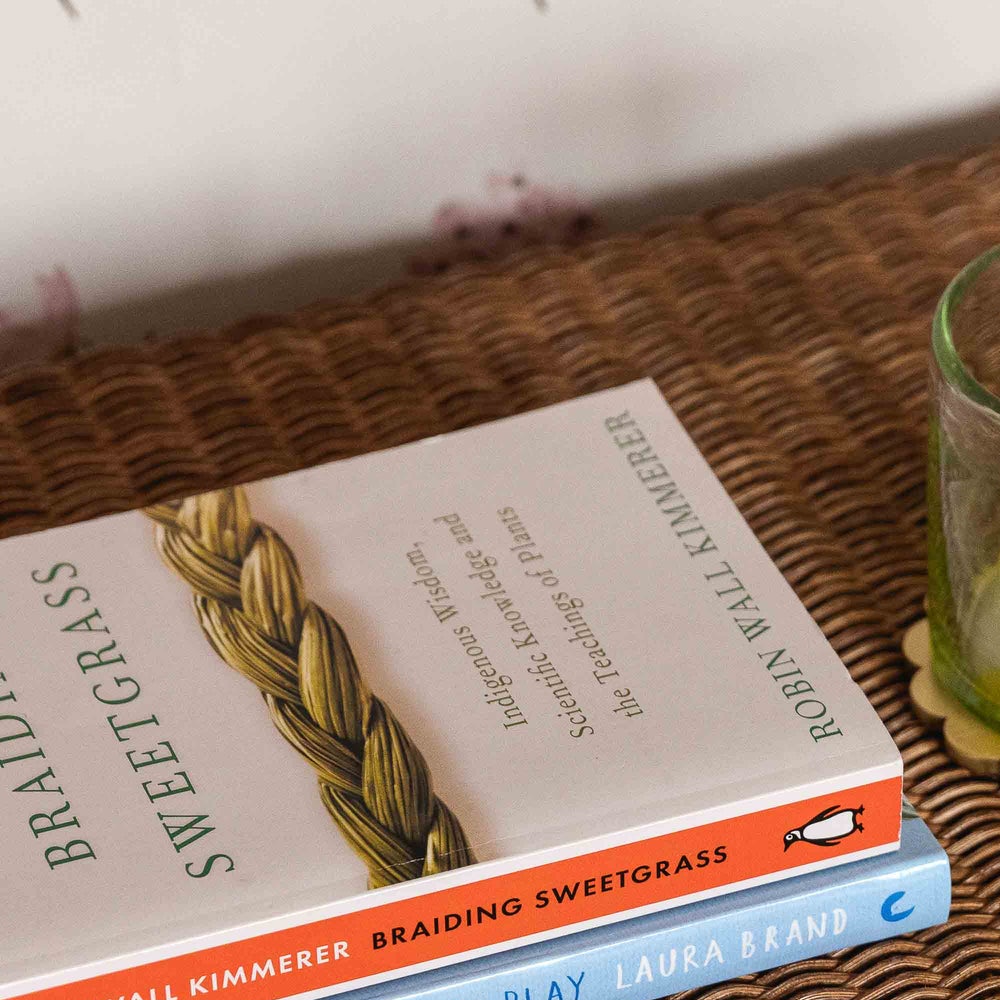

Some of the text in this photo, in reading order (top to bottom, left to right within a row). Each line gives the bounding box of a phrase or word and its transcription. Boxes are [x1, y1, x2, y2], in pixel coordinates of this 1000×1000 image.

[406, 541, 528, 729] Indigenous Wisdom,
[433, 513, 594, 738] Scientific Knowledge and
[497, 506, 643, 718] the Teachings of Plants
[604, 409, 844, 744] ROBIN WALL KIMMERER
[0, 671, 97, 870] BRAID
[31, 562, 235, 878] SWEETGRASS
[188, 940, 350, 996] KIMMERER
[371, 896, 523, 951] BRAIDING
[534, 844, 728, 909] SWEETGRASS
[615, 942, 724, 990] LAURA
[741, 907, 849, 958] BRAND
